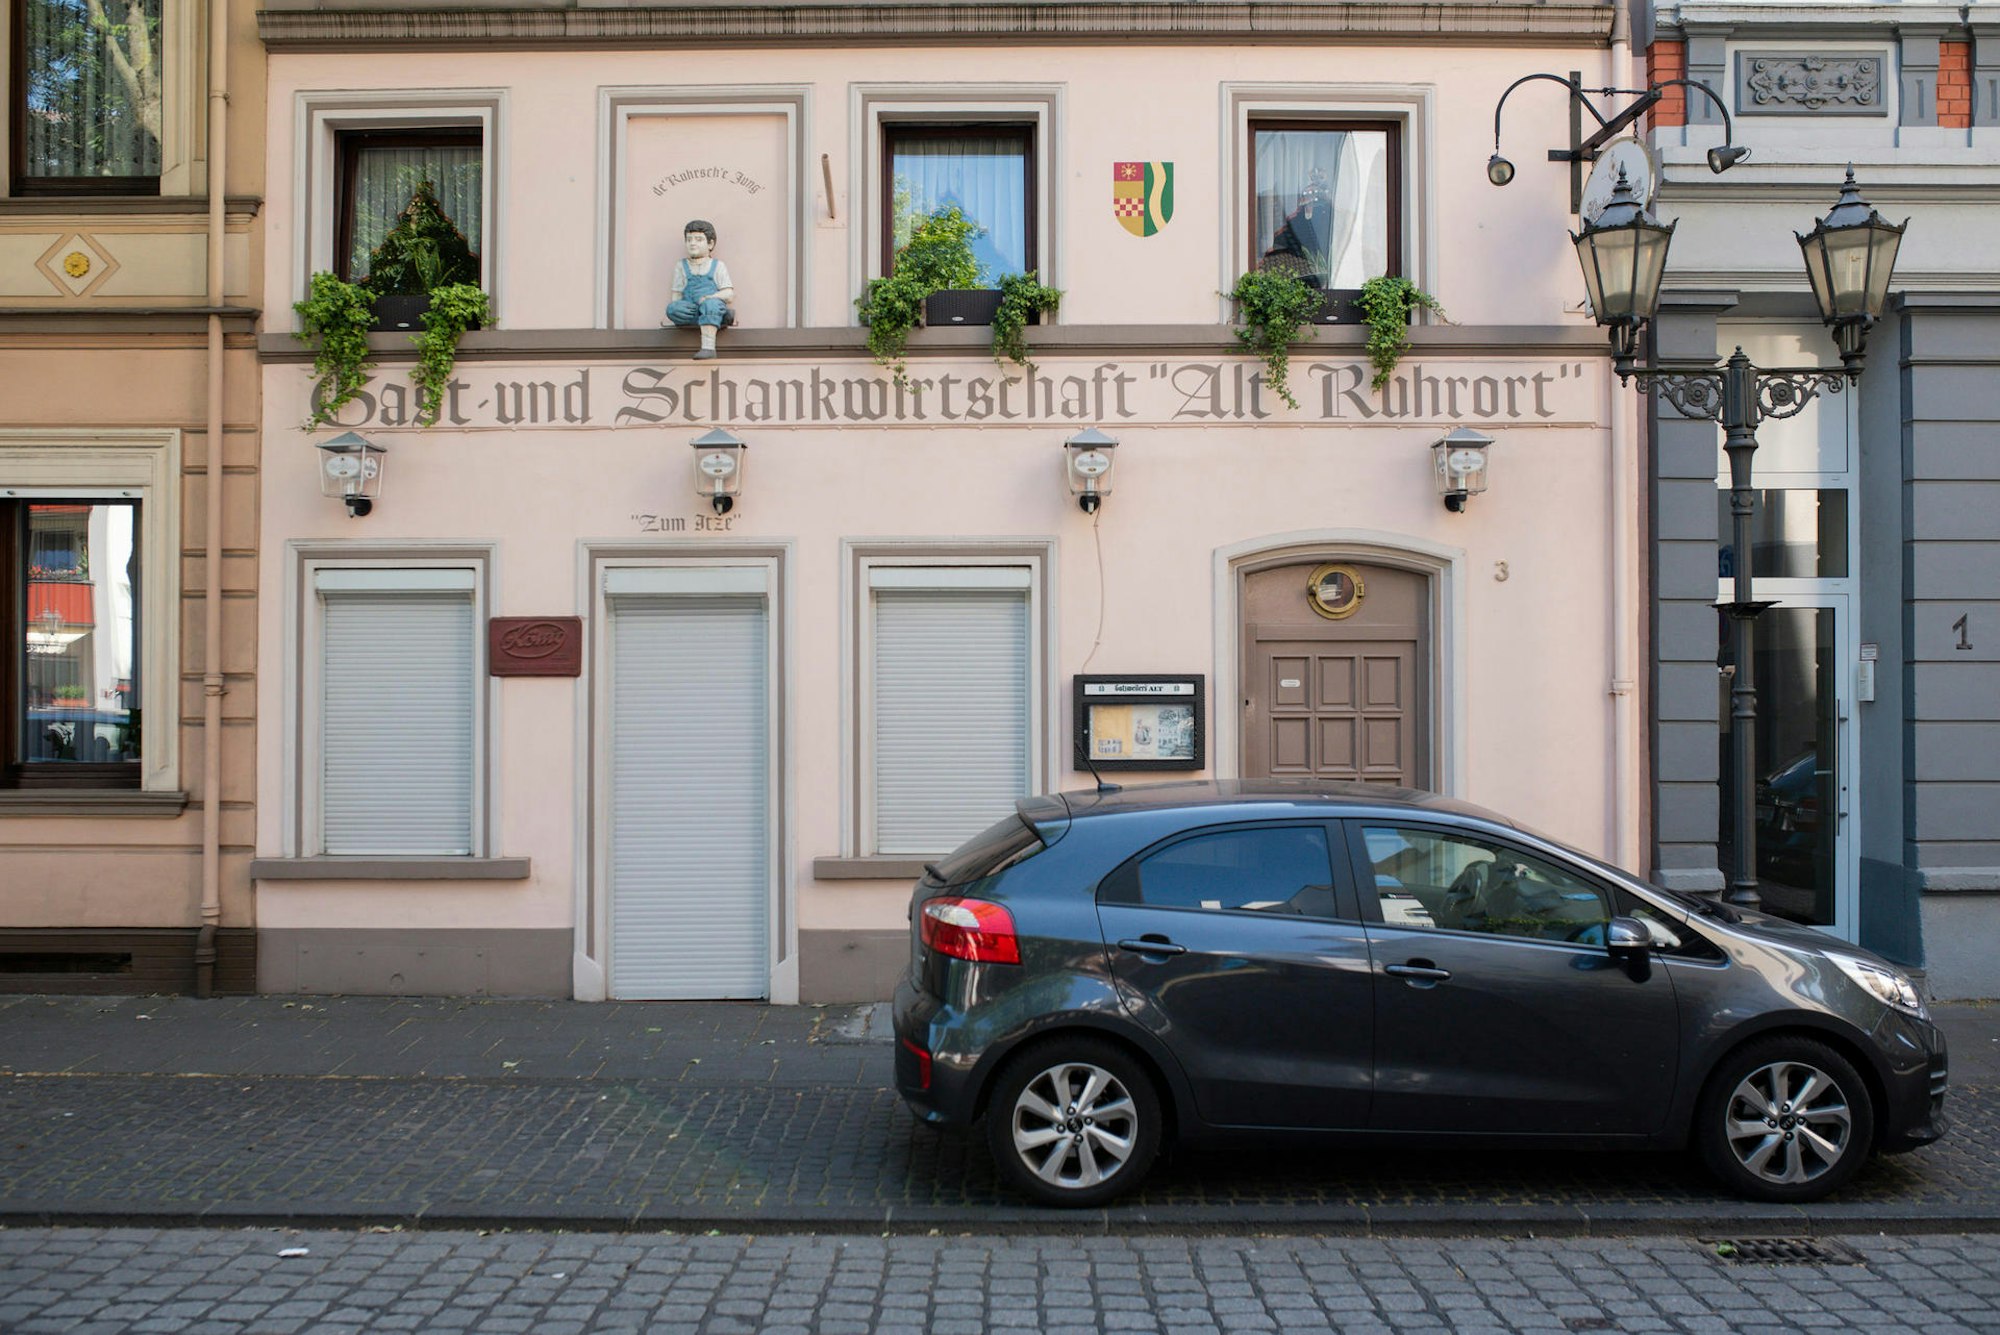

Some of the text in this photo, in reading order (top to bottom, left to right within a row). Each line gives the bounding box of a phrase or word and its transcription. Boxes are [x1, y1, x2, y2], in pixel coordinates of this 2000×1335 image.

[614, 363, 1139, 424] Schankwirtschaft
[1150, 363, 1272, 421] "Alt
[1307, 363, 1582, 421] Ruhrort"
[630, 514, 686, 532] "Zum
[1493, 559, 1510, 583] 3
[1952, 612, 1974, 650] 1
